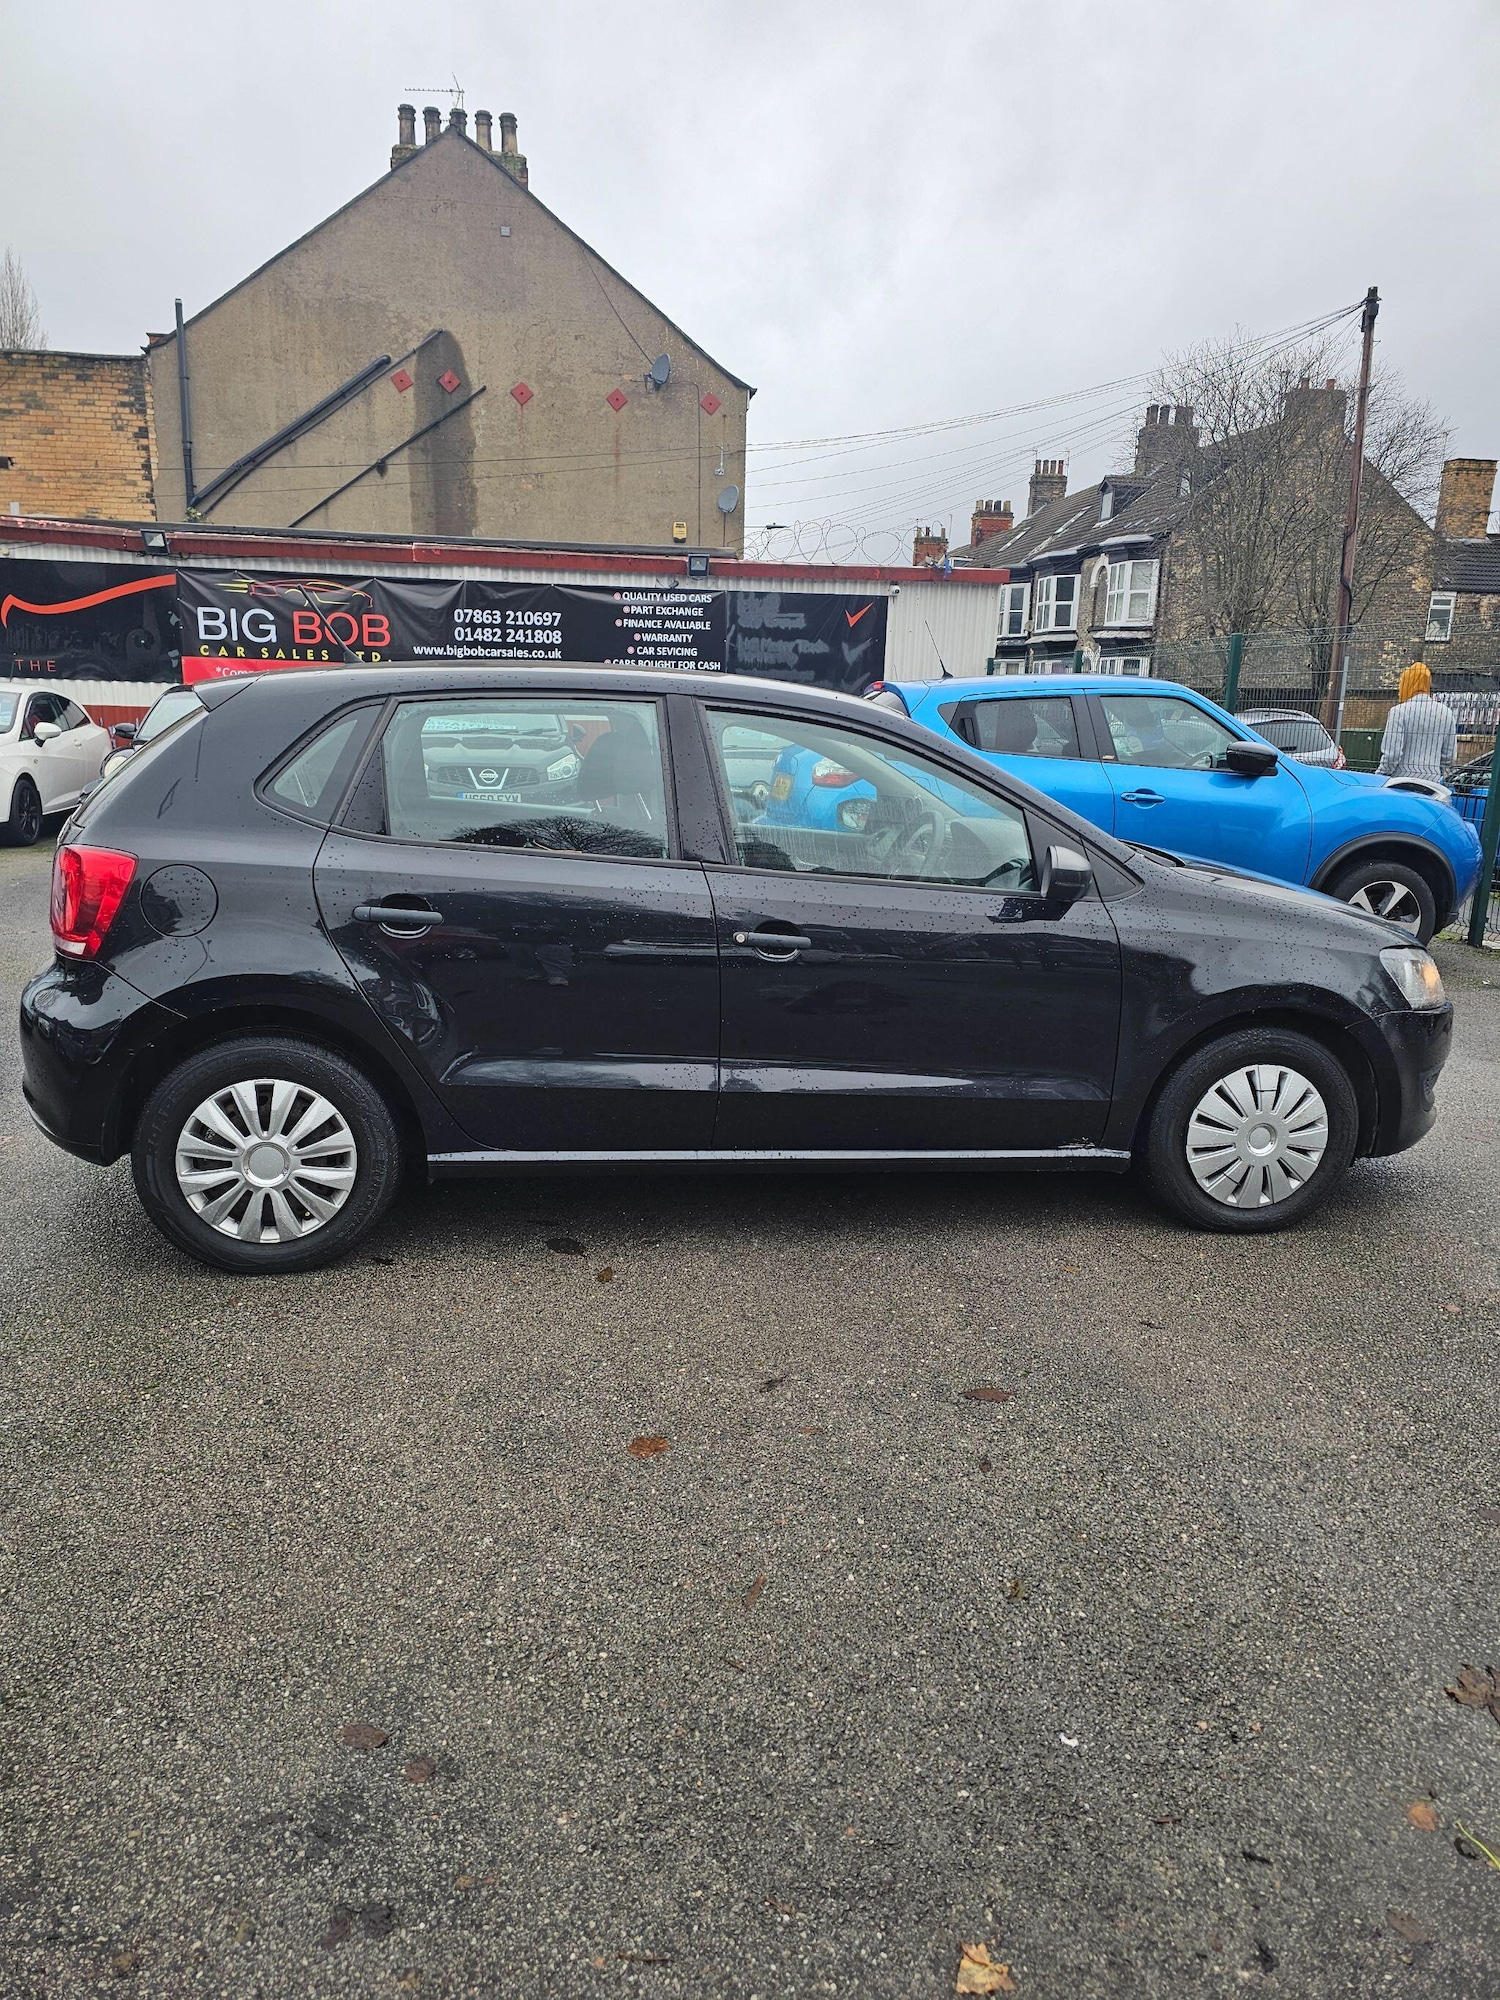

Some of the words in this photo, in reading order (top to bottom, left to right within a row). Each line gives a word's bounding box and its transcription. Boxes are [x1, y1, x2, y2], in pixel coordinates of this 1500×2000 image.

[622, 592, 661, 603] QUALITY
[663, 593, 687, 602] USED
[689, 594, 712, 603] CARS
[631, 605, 654, 615] PART
[656, 606, 704, 616] EXCHANGE
[453, 608, 501, 624] 07863
[505, 610, 562, 626] 210697
[197, 606, 277, 643] BIG
[293, 610, 391, 647] BOB
[623, 618, 662, 629] FINANCE
[664, 620, 711, 630] AVALIABLE
[454, 627, 502, 642] 01482
[505, 629, 562, 644] 241808
[641, 633, 693, 643] WARRANTY
[200, 645, 246, 658] CAR
[261, 647, 329, 661] SALES
[413, 644, 562, 659] www.bigbobcarsales.co.uk
[637, 646, 655, 656] CAR
[657, 647, 698, 657] SEVICING
[15, 659, 56, 672] THE
[638, 660, 676, 669] BOUGHT
[678, 661, 696, 670] FOR
[697, 661, 721, 671] CASH
